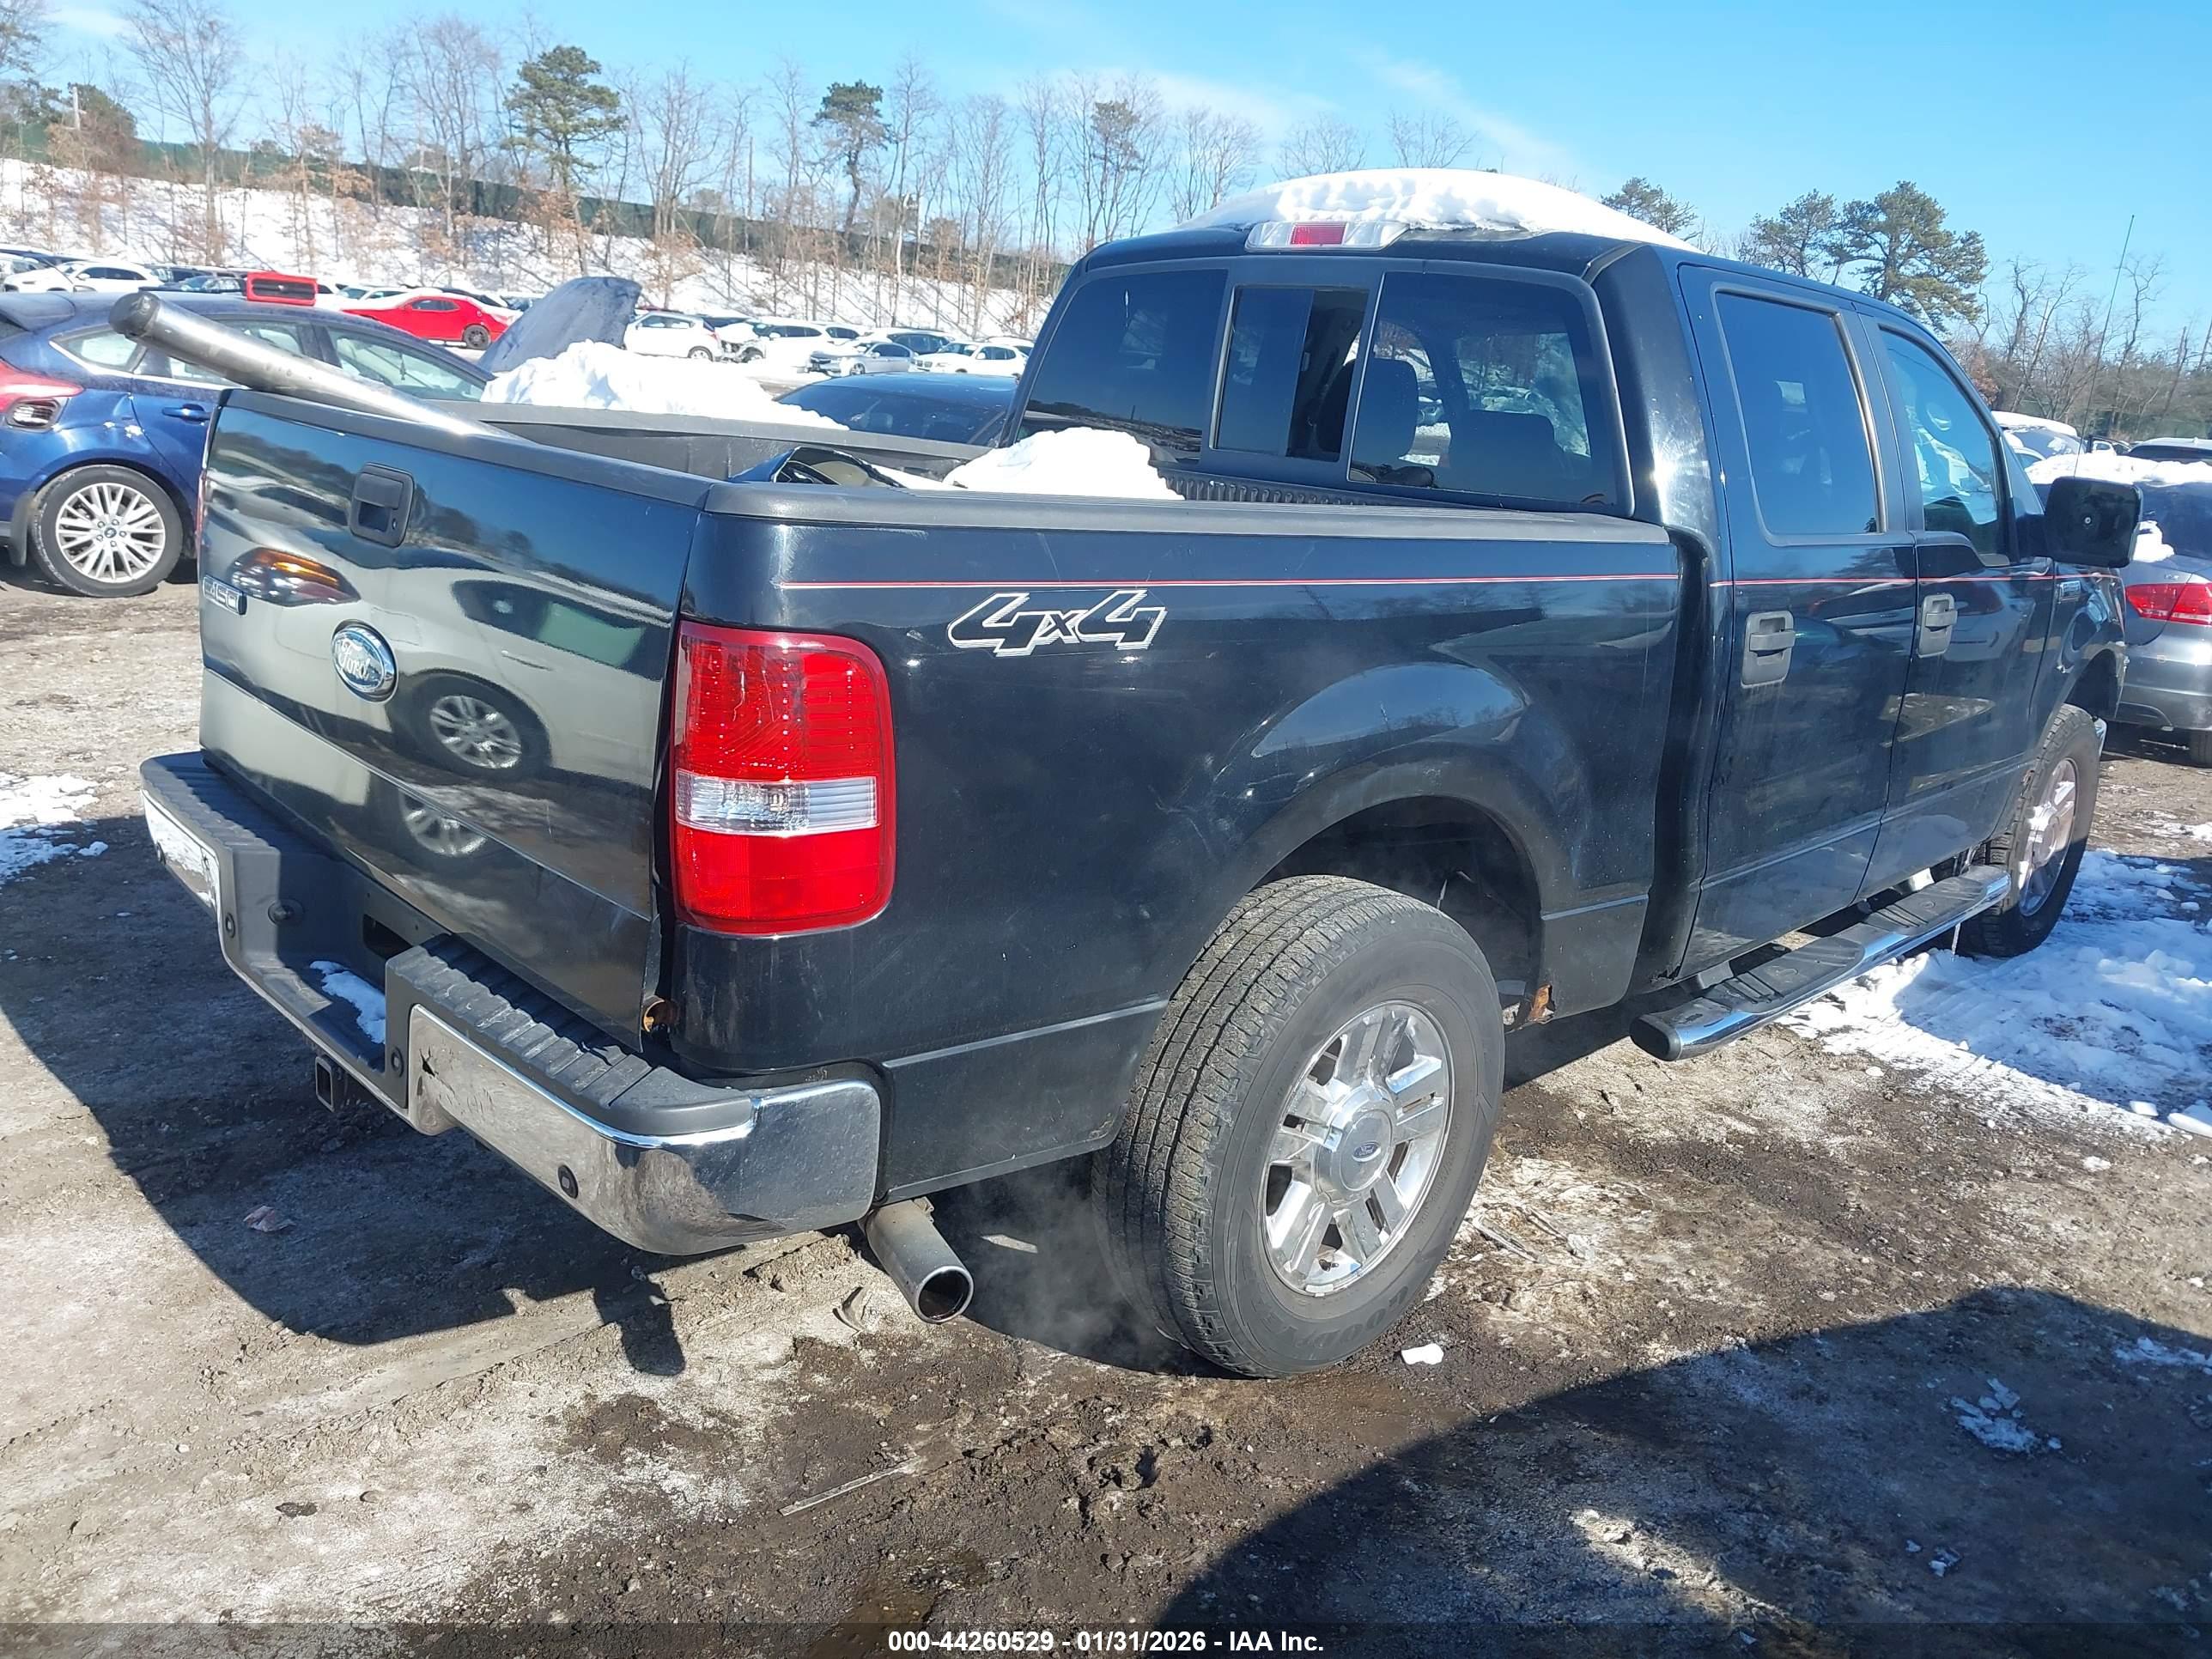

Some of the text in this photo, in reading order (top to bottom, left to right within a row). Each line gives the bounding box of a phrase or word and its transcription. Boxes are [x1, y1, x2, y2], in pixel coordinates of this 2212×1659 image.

[203, 575, 240, 615] 150
[947, 590, 1168, 657] 4x4
[335, 638, 372, 681] Ford
